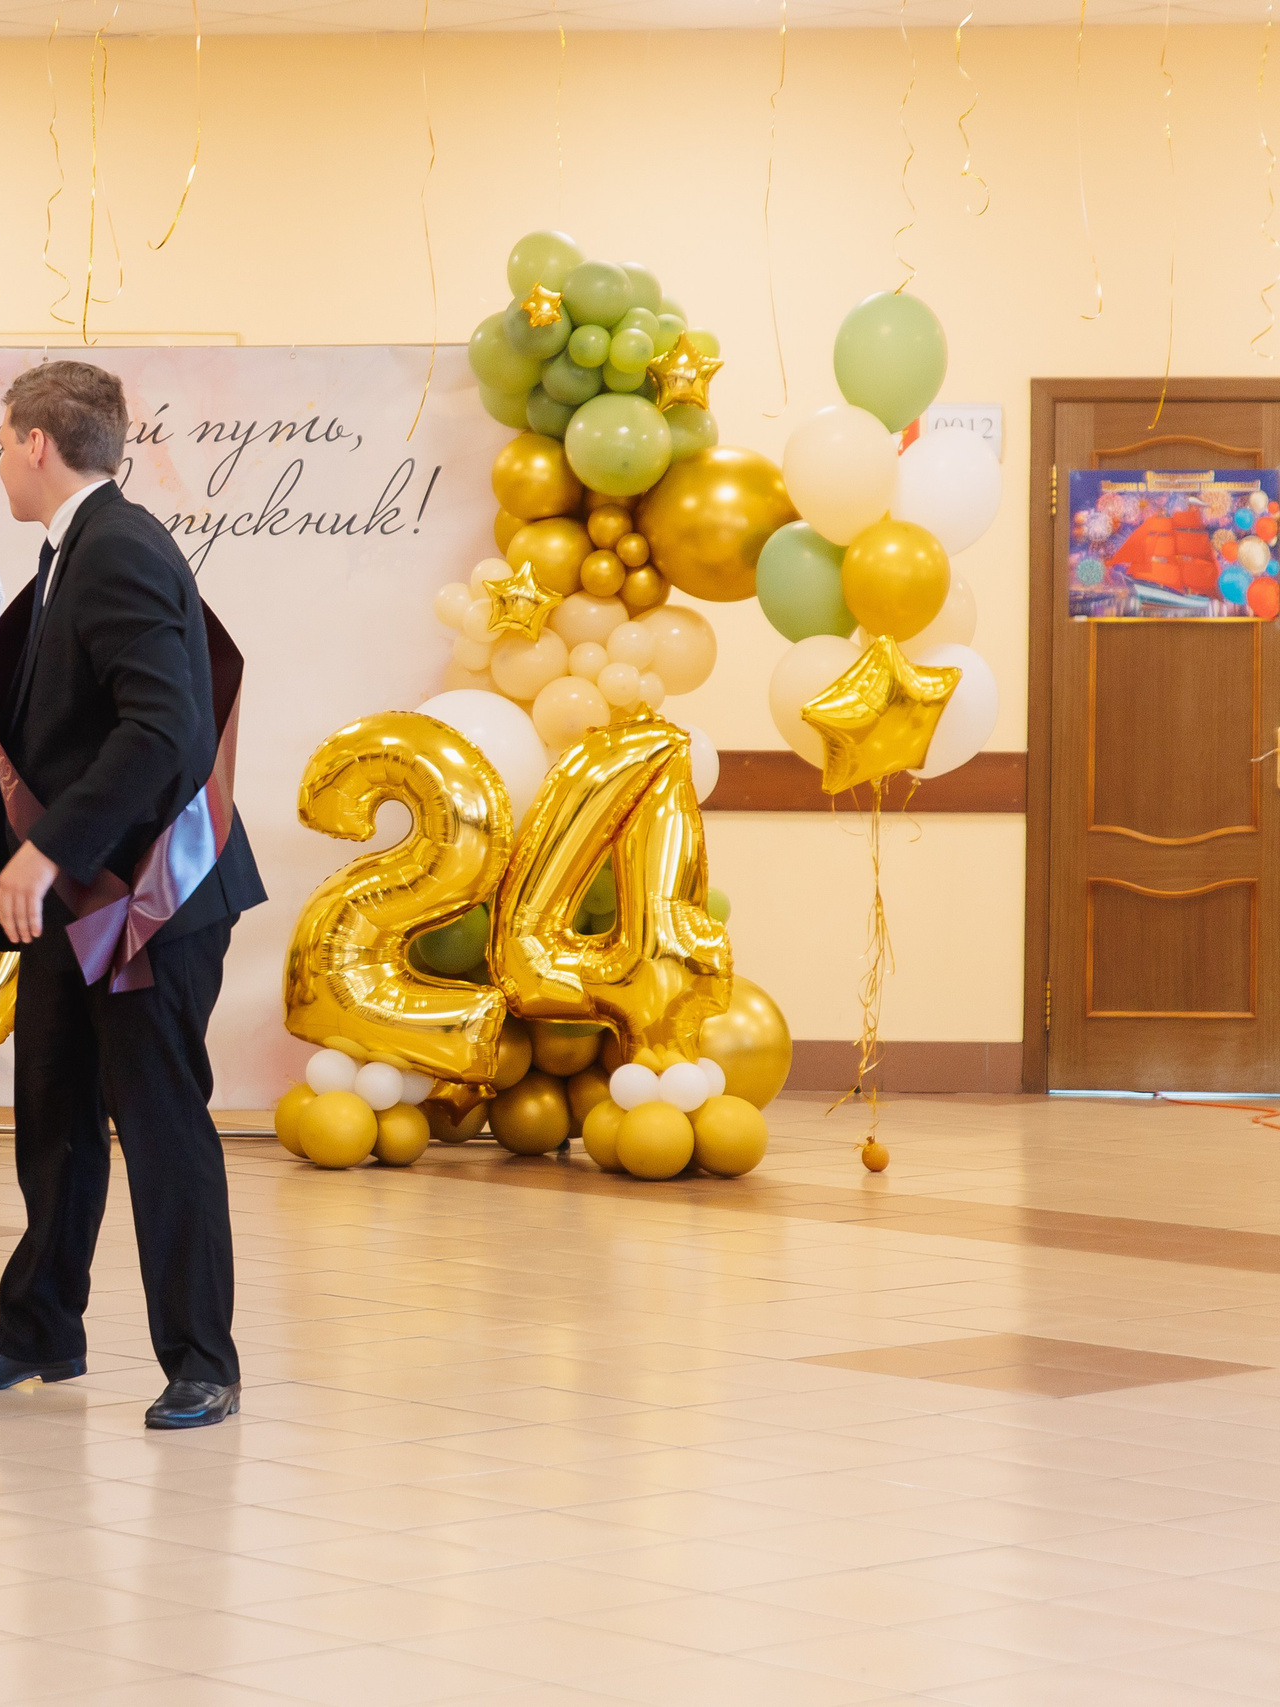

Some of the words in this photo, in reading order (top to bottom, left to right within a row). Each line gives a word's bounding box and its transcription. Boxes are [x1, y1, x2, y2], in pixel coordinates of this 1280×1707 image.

[187, 415, 363, 497] путь,
[120, 457, 442, 577] пускник!
[284, 702, 735, 1086] 24
